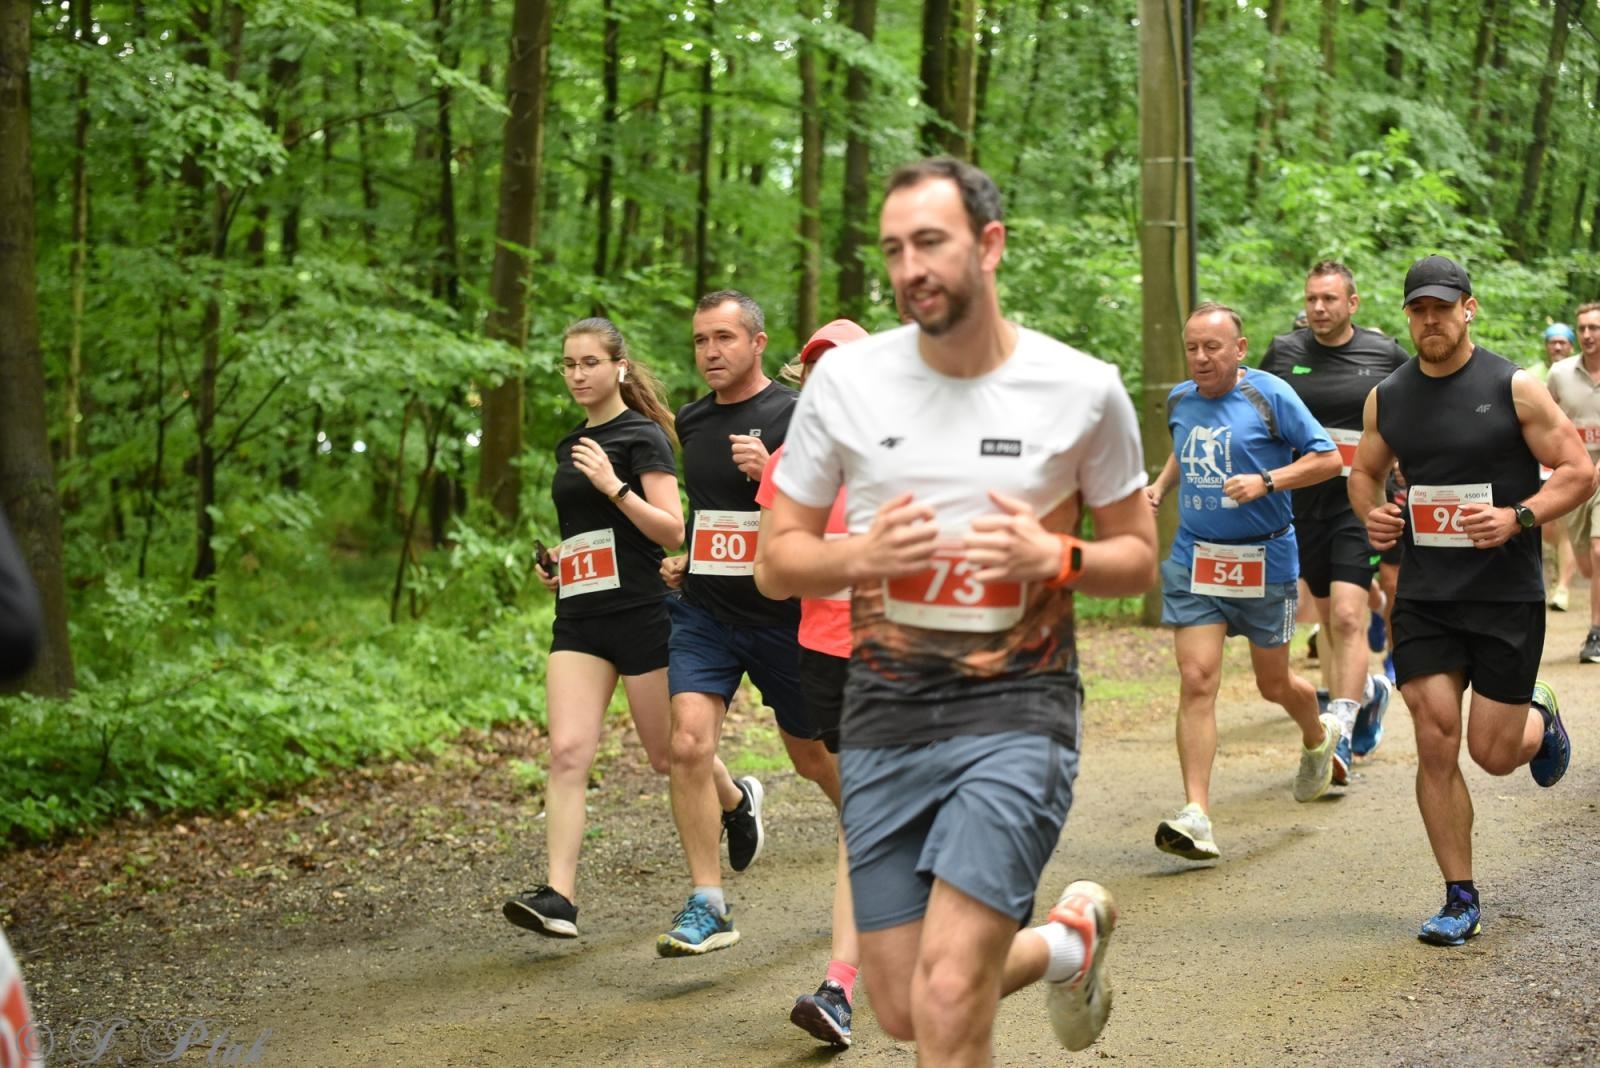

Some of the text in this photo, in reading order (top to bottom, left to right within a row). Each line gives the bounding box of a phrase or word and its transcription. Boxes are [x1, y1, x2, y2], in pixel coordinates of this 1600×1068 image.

[1475, 404, 1491, 413] 4F
[710, 533, 746, 560] 80
[571, 553, 597, 580] 11
[1213, 562, 1245, 585] 54
[923, 560, 985, 604] 73
